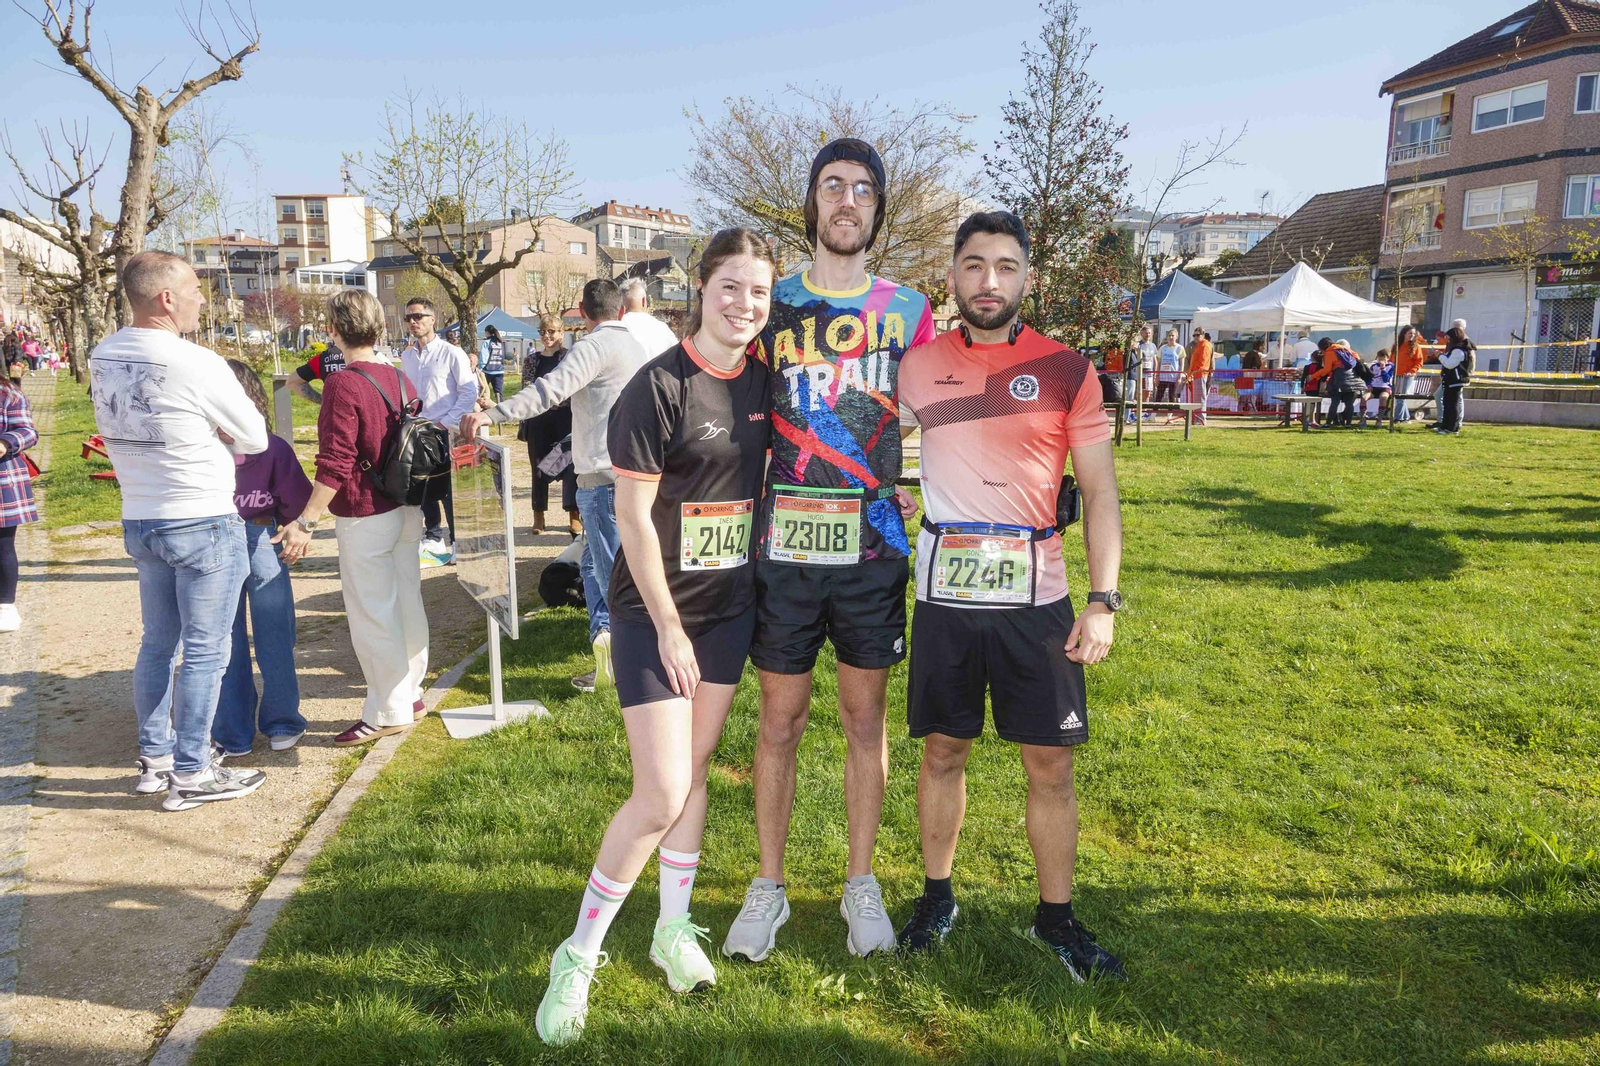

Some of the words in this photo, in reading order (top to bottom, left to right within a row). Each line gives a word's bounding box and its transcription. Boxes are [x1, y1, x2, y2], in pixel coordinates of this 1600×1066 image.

[774, 310, 905, 372] ALOIA
[782, 351, 892, 411] TRAIL
[699, 524, 745, 557] 2142
[783, 519, 847, 552] 2308
[947, 557, 1014, 590] 2246
[1060, 721, 1082, 730] adidas
